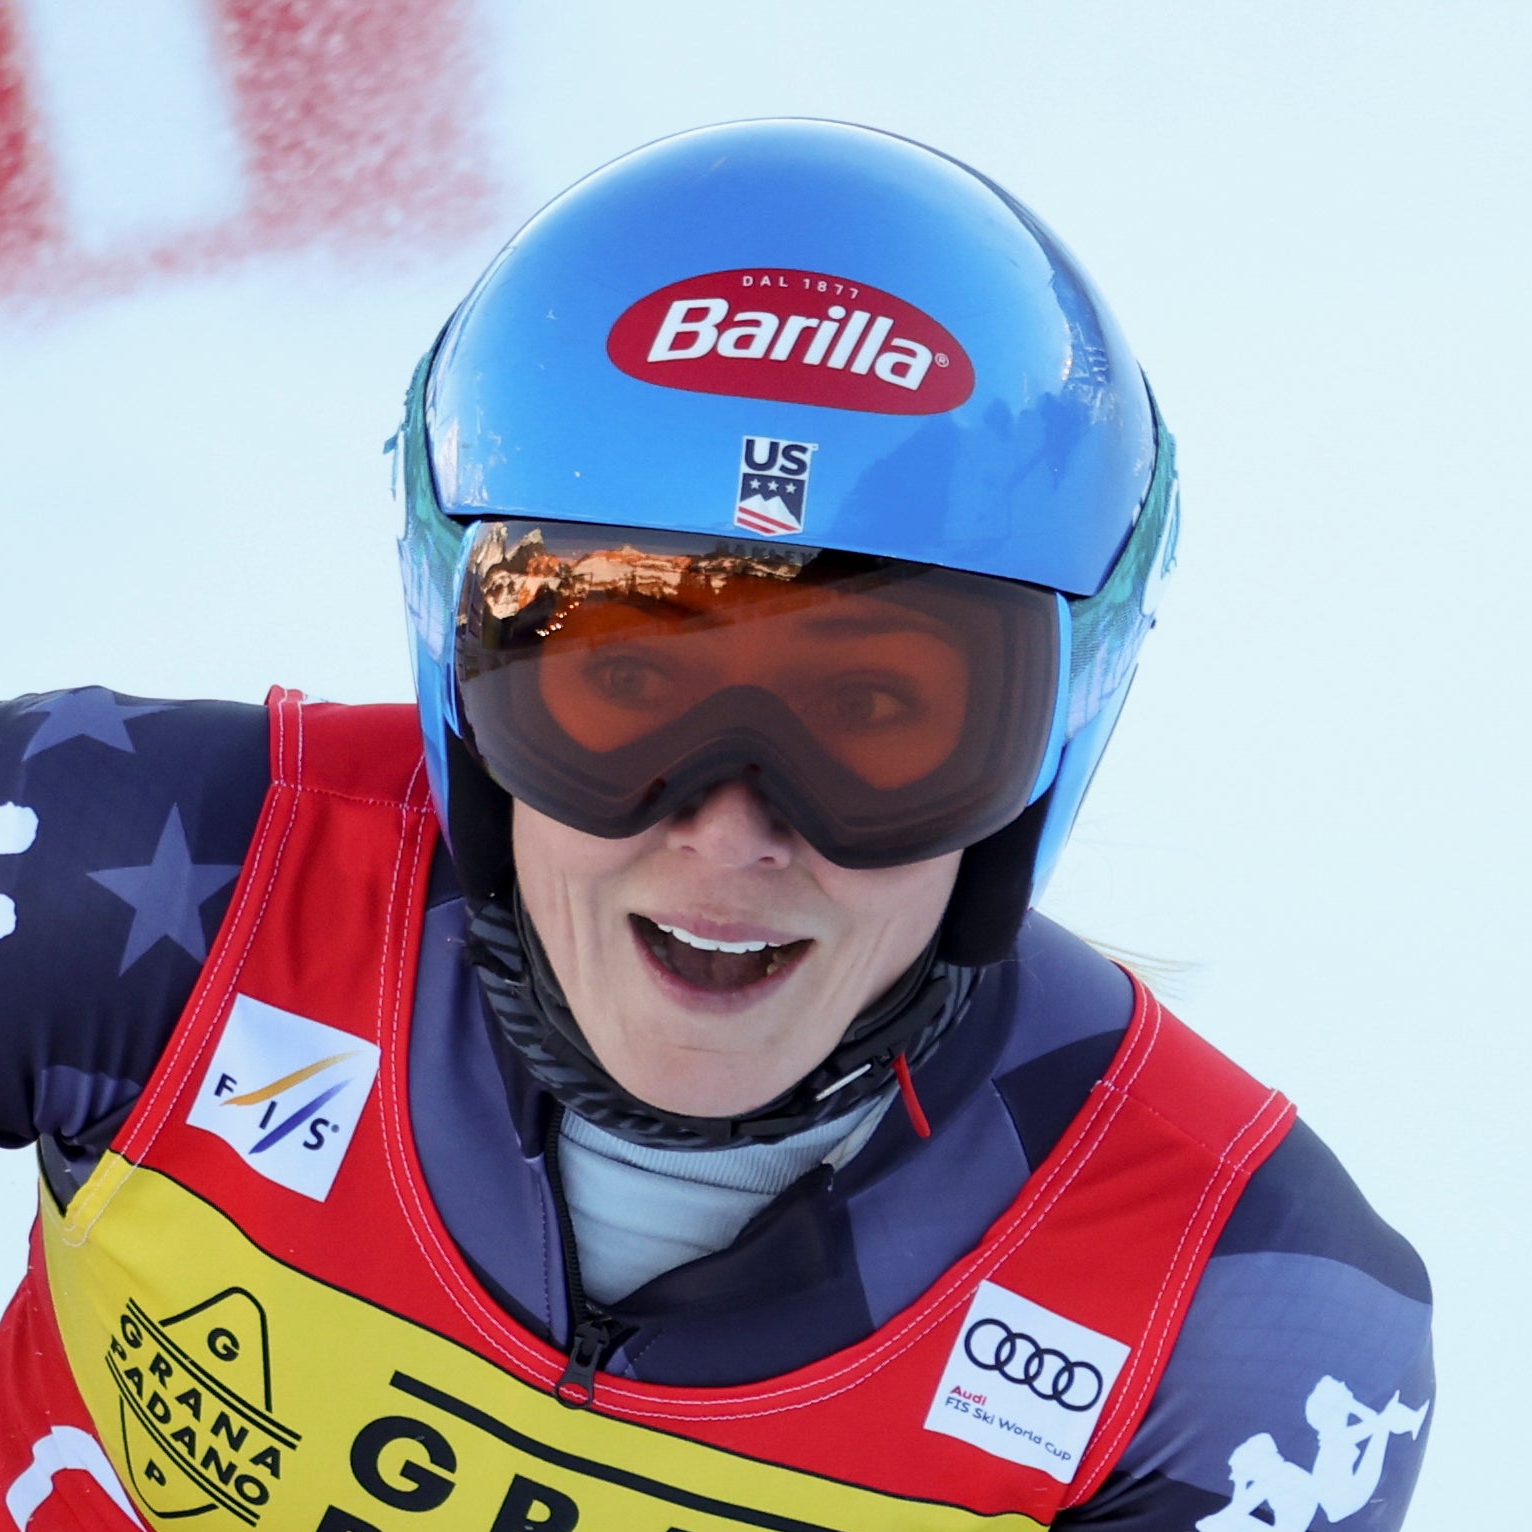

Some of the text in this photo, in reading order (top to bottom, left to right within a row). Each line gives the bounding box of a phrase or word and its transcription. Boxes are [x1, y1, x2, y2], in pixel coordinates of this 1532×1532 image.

[741, 275, 859, 300] DAL 1877
[646, 297, 934, 392] Barilla
[743, 437, 809, 477] US
[213, 1072, 331, 1152] FIS
[206, 1327, 240, 1362] G
[109, 1334, 269, 1506] PADANO
[120, 1314, 281, 1480] GRANA
[949, 1385, 988, 1406] Audi
[944, 1396, 1072, 1461] FIS Ski World Cup
[144, 1459, 167, 1487] P
